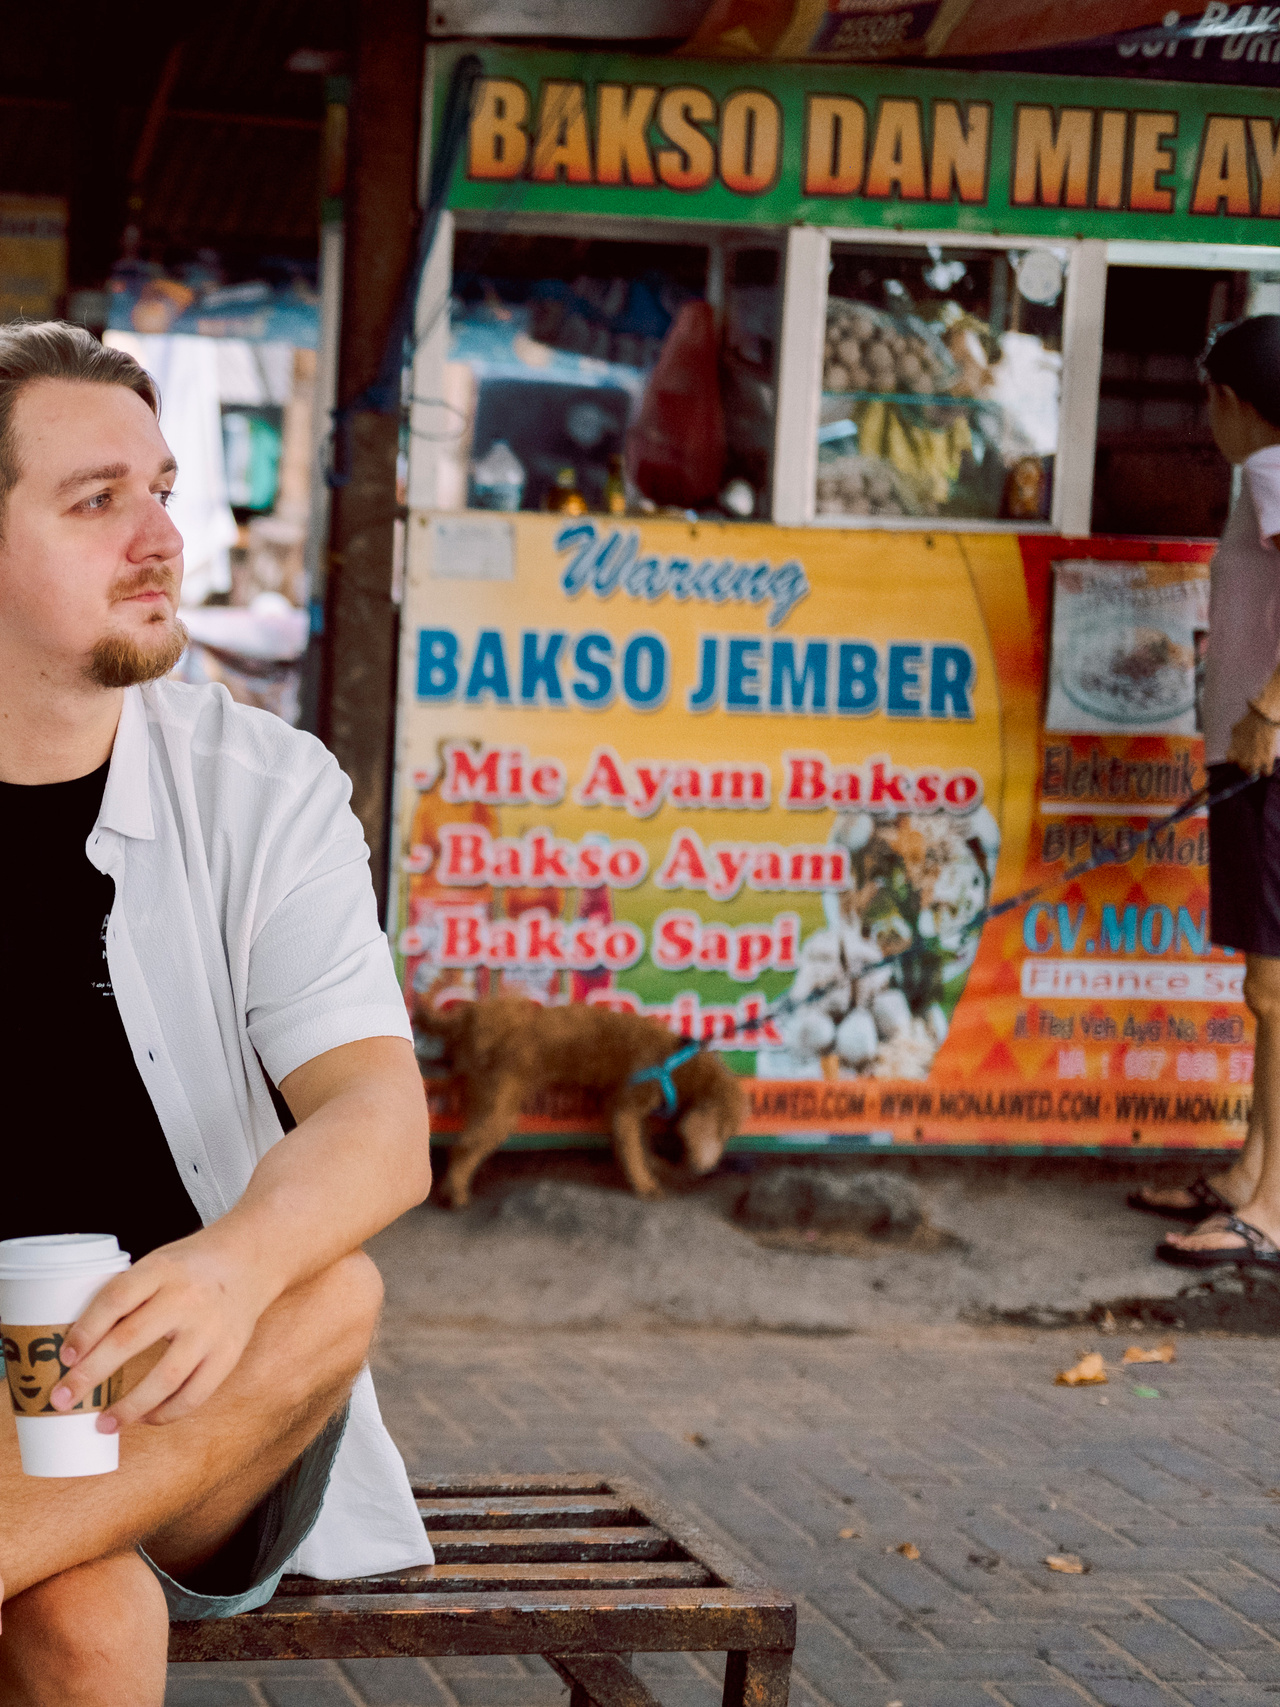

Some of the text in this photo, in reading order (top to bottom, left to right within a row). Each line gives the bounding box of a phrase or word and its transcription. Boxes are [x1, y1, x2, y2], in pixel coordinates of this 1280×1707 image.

[467, 77, 784, 194] BAKSO
[802, 91, 993, 207] DAN
[1010, 103, 1179, 214] MIE
[555, 524, 809, 628] Warung
[415, 629, 975, 720] BAKSO JEMBER
[447, 748, 980, 814] Mie Ayam Bakso
[1042, 745, 1197, 799] Elektronik
[442, 830, 849, 895] Bakso Ayam
[440, 913, 798, 977] Bakso Sapi
[1029, 960, 1191, 997] Finance
